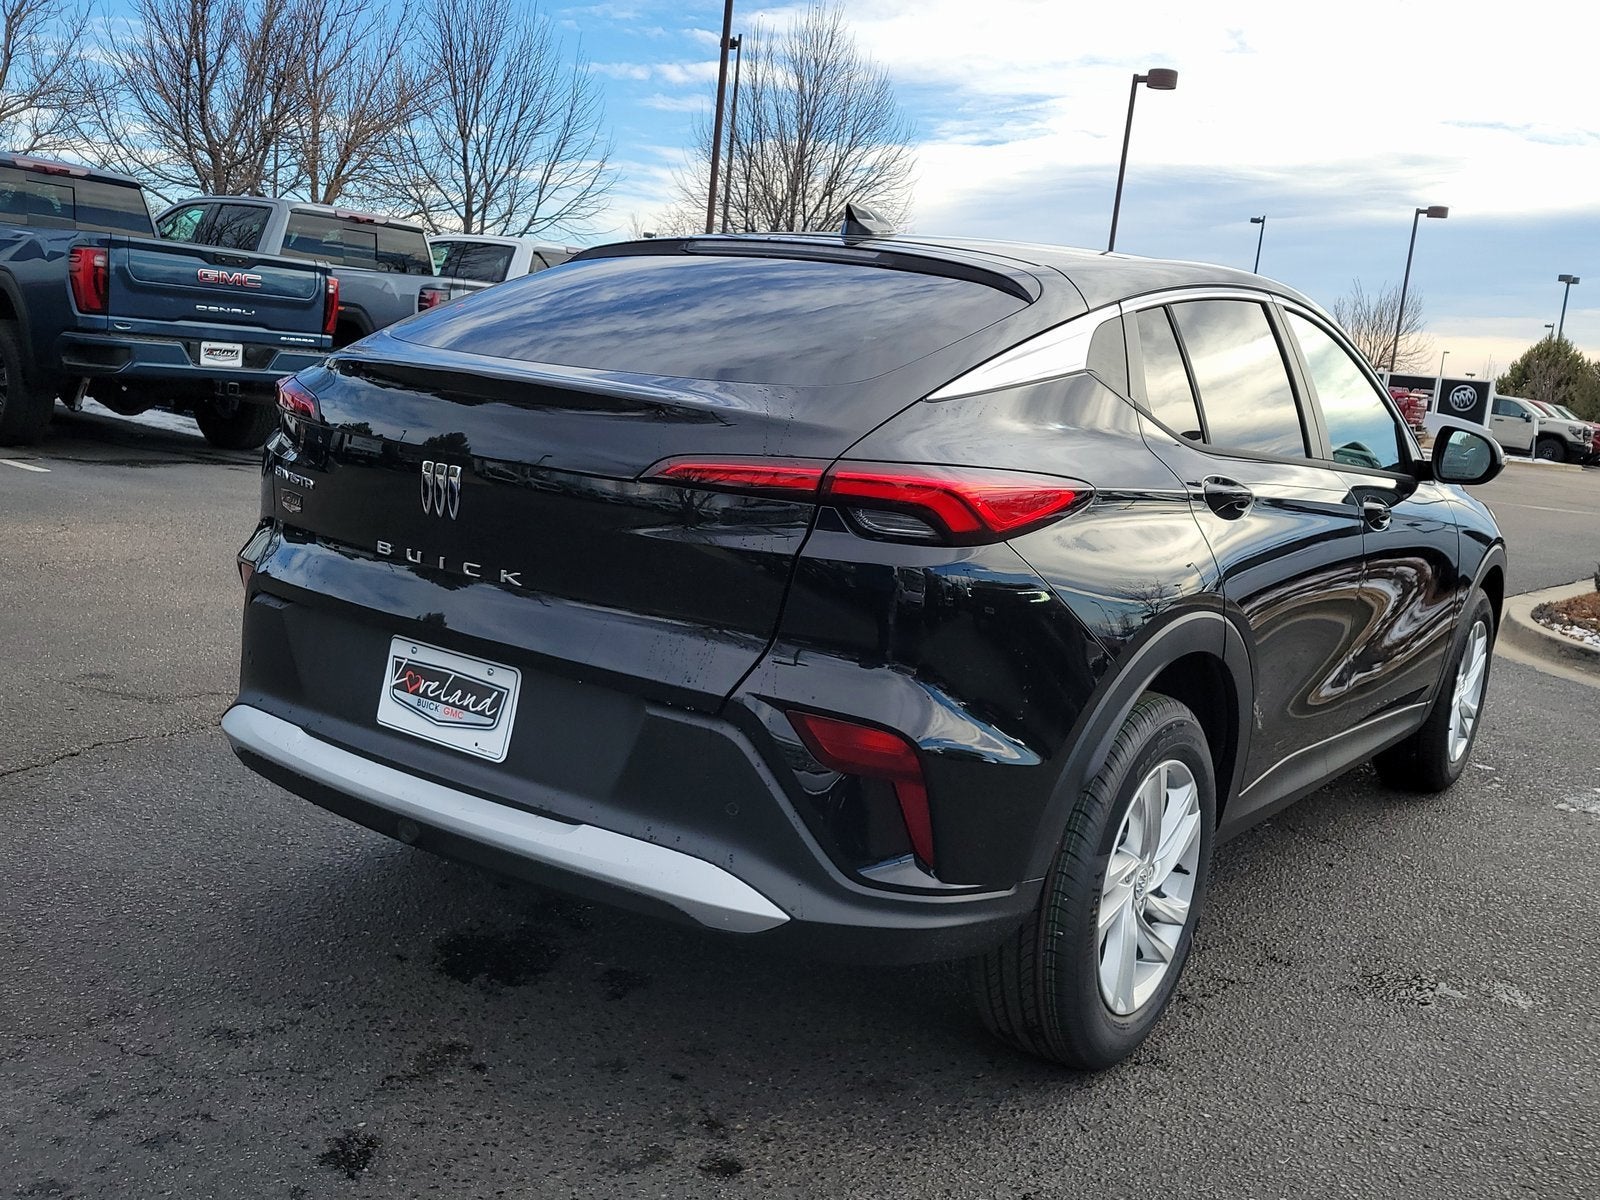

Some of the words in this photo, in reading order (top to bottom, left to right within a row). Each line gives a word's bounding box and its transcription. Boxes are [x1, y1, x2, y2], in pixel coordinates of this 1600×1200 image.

[197, 268, 262, 289] GMC
[195, 304, 256, 316] DENALI
[376, 540, 522, 587] BUICK
[390, 658, 499, 716] Loveland
[416, 698, 441, 713] BUICK
[443, 706, 465, 720] GMC
